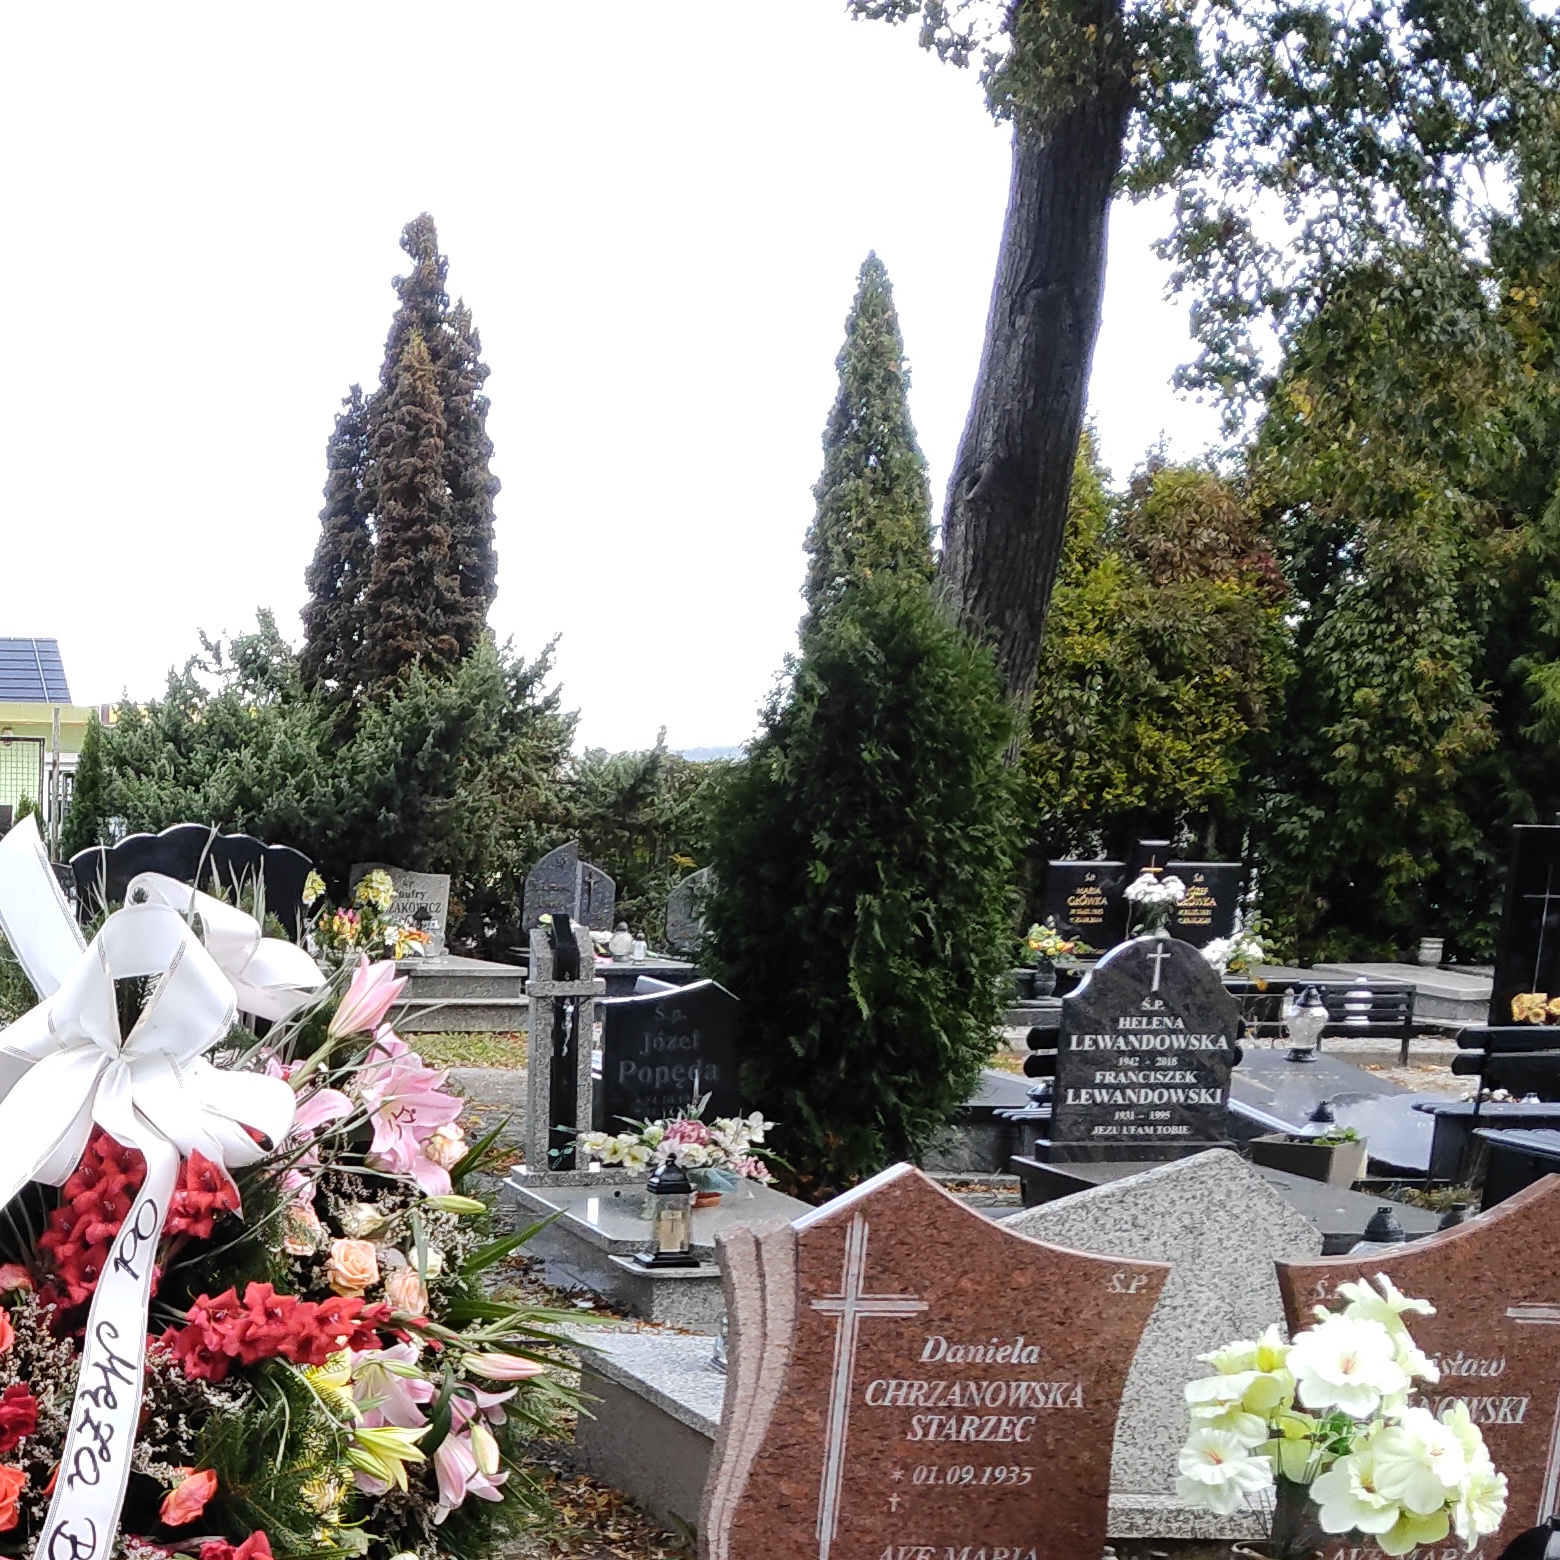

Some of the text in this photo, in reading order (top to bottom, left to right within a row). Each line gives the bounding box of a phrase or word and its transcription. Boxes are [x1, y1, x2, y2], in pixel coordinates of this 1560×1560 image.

[1116, 1015, 1185, 1030] HELENA
[639, 1030, 702, 1057] Józef
[1069, 1034, 1230, 1051] LEWANDOWSKA
[1093, 1070, 1199, 1084] FRANCISZEK
[1065, 1087, 1224, 1105] LEWANDOWSKI
[919, 1335, 1041, 1365] Daniela
[864, 1379, 1085, 1409] CHRZANOWSKA
[1414, 1395, 1532, 1425] NOWSKI
[906, 1414, 1038, 1443] STARZEC
[912, 1464, 1034, 1487] 01.09.1935
